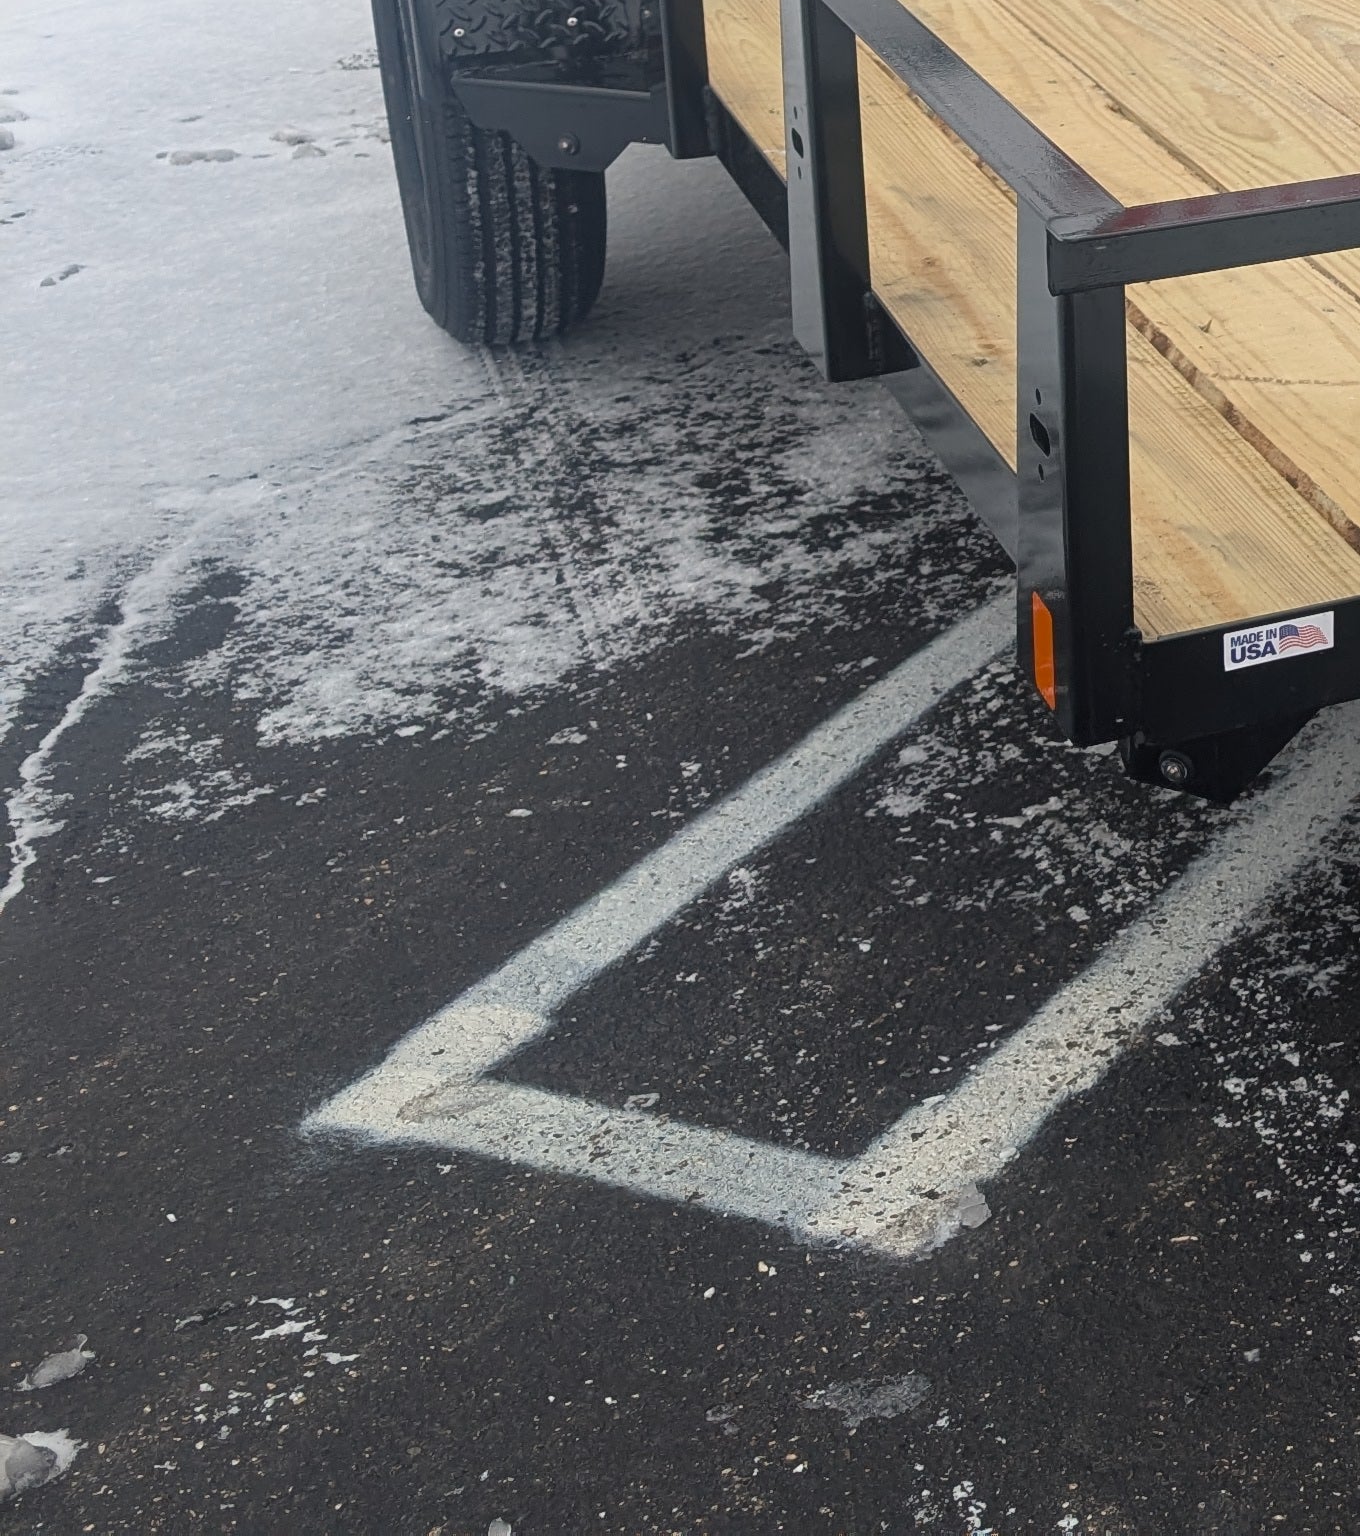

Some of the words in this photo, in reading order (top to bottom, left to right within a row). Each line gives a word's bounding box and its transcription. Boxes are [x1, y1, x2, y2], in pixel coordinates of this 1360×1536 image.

[1230, 630, 1264, 648] MADE
[1265, 628, 1278, 640] IN
[1230, 641, 1278, 664] USA
